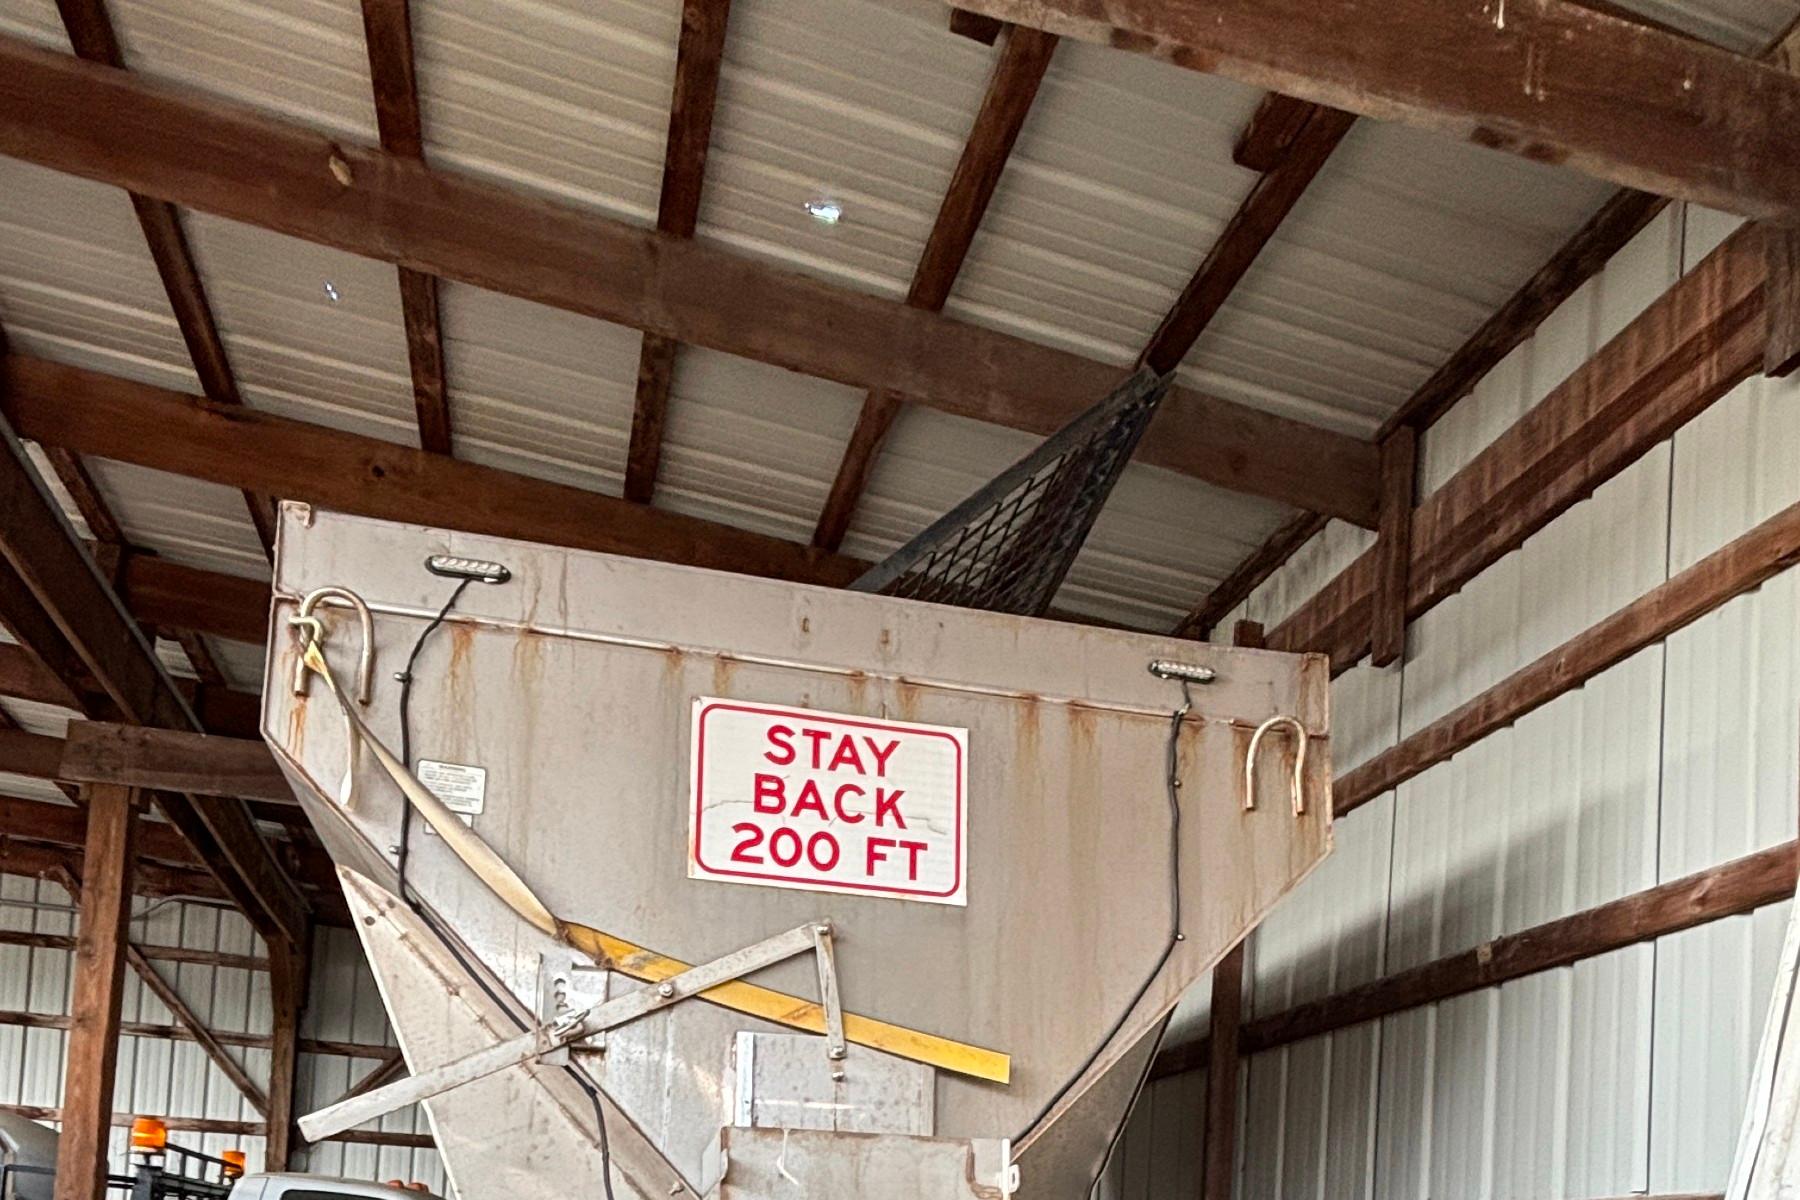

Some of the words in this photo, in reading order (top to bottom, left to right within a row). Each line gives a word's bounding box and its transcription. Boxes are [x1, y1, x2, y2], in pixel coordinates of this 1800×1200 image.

[763, 724, 901, 778] STAY
[753, 772, 908, 830] BACK
[730, 822, 841, 873] 200
[866, 836, 929, 881] FT
